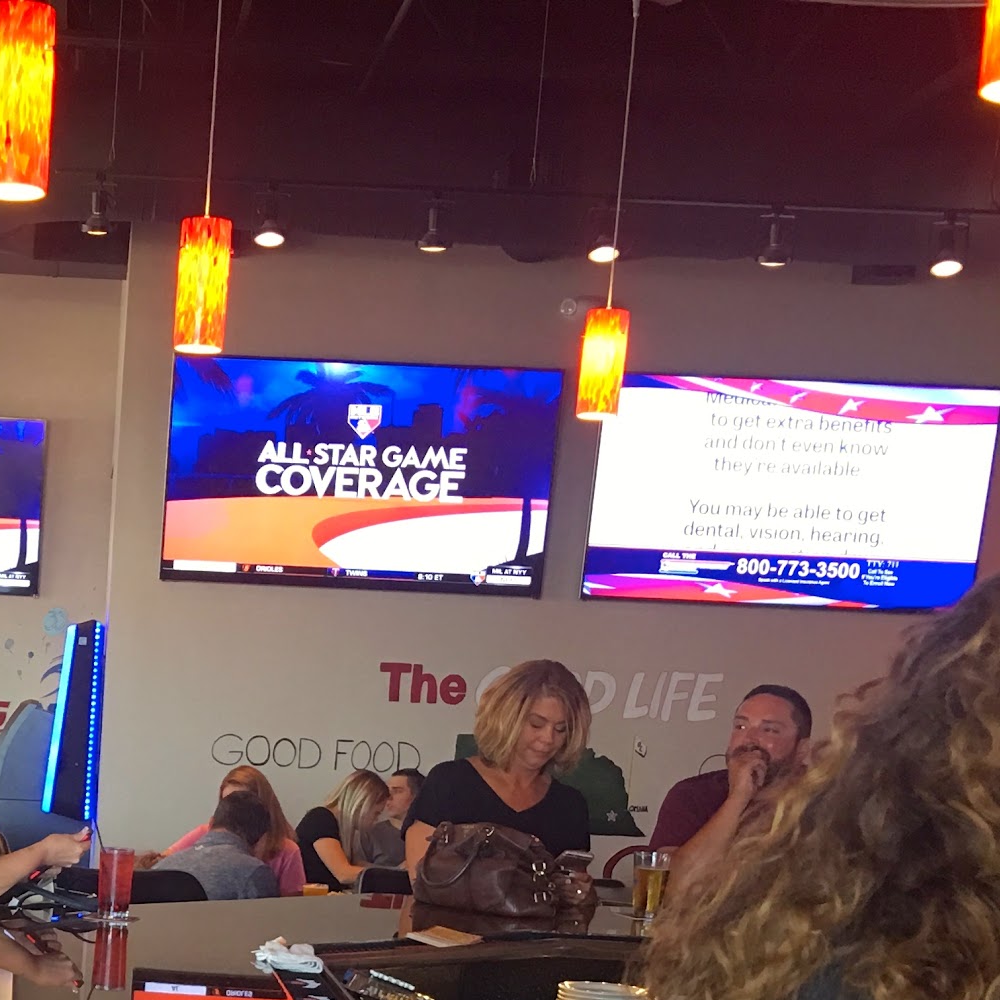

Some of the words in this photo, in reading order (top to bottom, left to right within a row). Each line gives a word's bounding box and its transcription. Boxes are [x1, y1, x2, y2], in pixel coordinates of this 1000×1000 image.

[711, 413, 728, 426] to
[733, 414, 761, 431] get
[766, 416, 813, 431] extra
[819, 415, 893, 433] benefits
[257, 439, 310, 464] ALL
[313, 442, 378, 467] STAR
[381, 445, 468, 471] GAME
[704, 434, 738, 449] and
[792, 440, 834, 453] even
[839, 438, 889, 455] know
[781, 460, 860, 477] available
[255, 463, 466, 503] COVERAGE
[689, 499, 720, 515] You
[725, 503, 763, 520] may
[768, 502, 788, 518] be
[793, 504, 831, 520] able
[836, 507, 853, 521] to
[858, 509, 886, 525] get
[255, 565, 283, 573] ORIOLES
[345, 568, 368, 577] TWINS
[736, 558, 860, 579] 800-773-3500
[379, 662, 467, 705] The
[622, 670, 725, 722] LIFE
[211, 733, 322, 769] GOOD
[333, 738, 421, 773] FOOD
